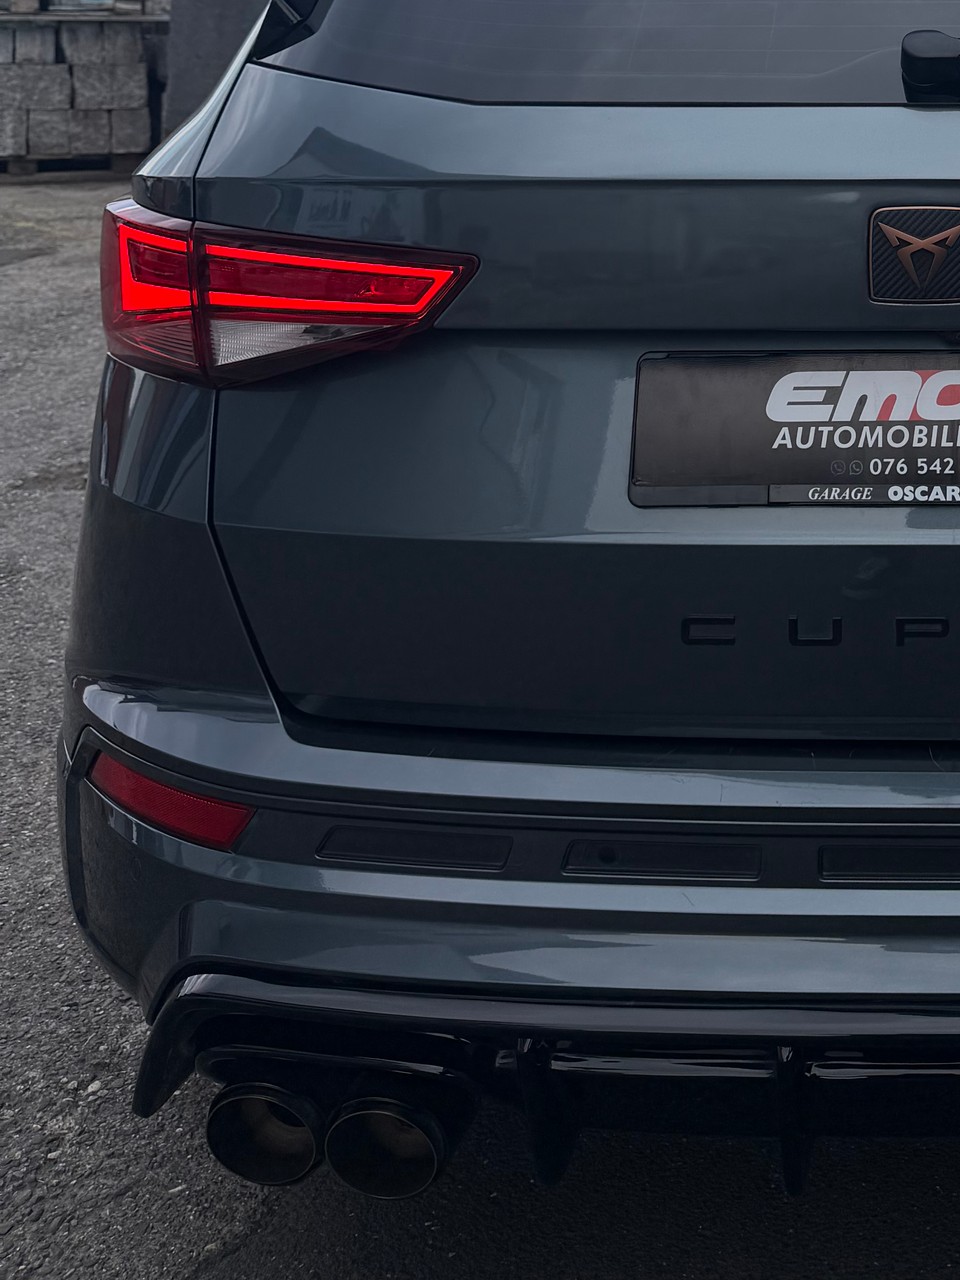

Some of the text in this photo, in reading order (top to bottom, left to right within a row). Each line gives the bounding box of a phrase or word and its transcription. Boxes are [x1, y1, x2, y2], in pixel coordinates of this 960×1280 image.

[869, 457, 908, 476] 076
[916, 457, 955, 475] 542
[807, 486, 873, 501] GARAGE
